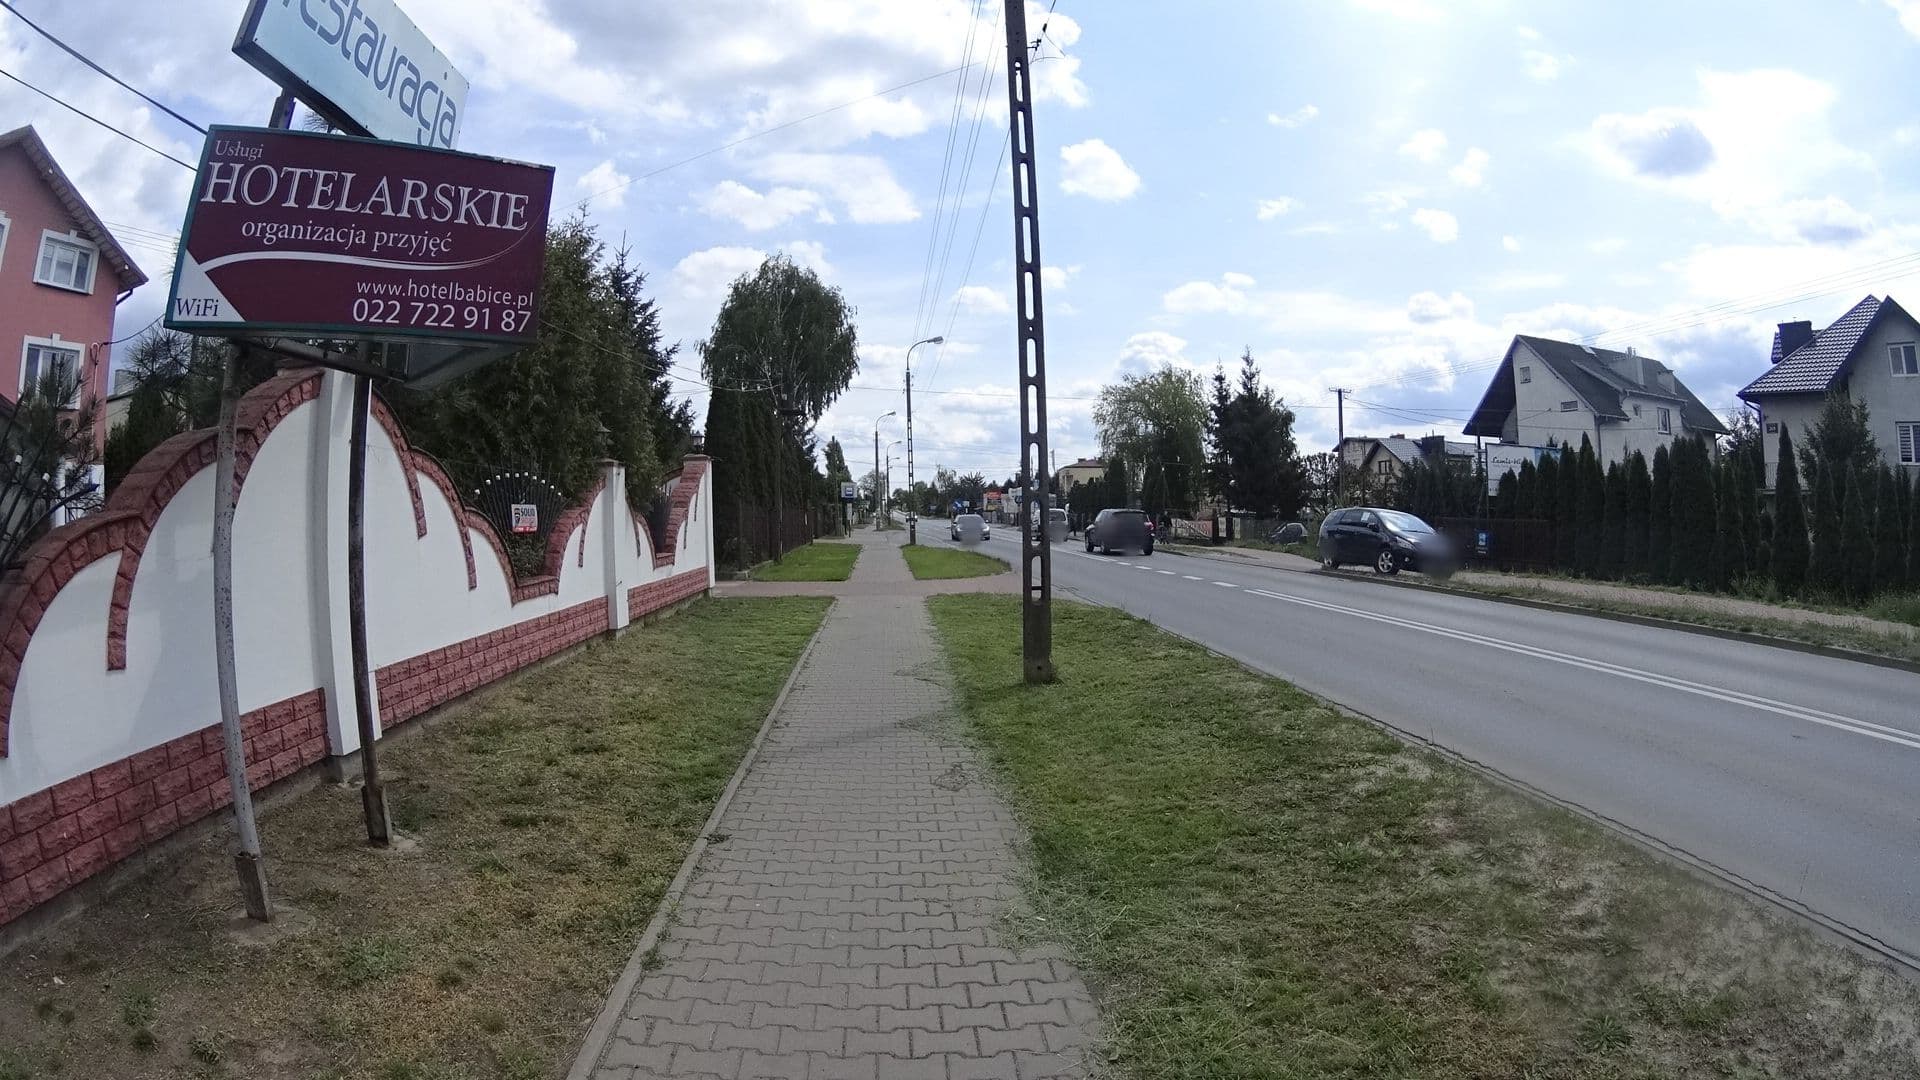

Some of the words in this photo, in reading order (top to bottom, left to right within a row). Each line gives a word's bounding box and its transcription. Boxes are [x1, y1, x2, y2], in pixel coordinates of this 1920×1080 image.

[283, 0, 457, 148] stauracja
[215, 140, 264, 161] Usługi
[201, 161, 529, 231] HOTELARSKIE
[242, 220, 367, 250] organizacja
[373, 231, 452, 257] przyjęć
[175, 297, 219, 317] WiFi
[357, 278, 534, 310] www.hotelbabice.pl
[353, 298, 401, 324] 022
[409, 302, 456, 328] 722
[463, 306, 490, 330] 91
[500, 309, 532, 333] 87
